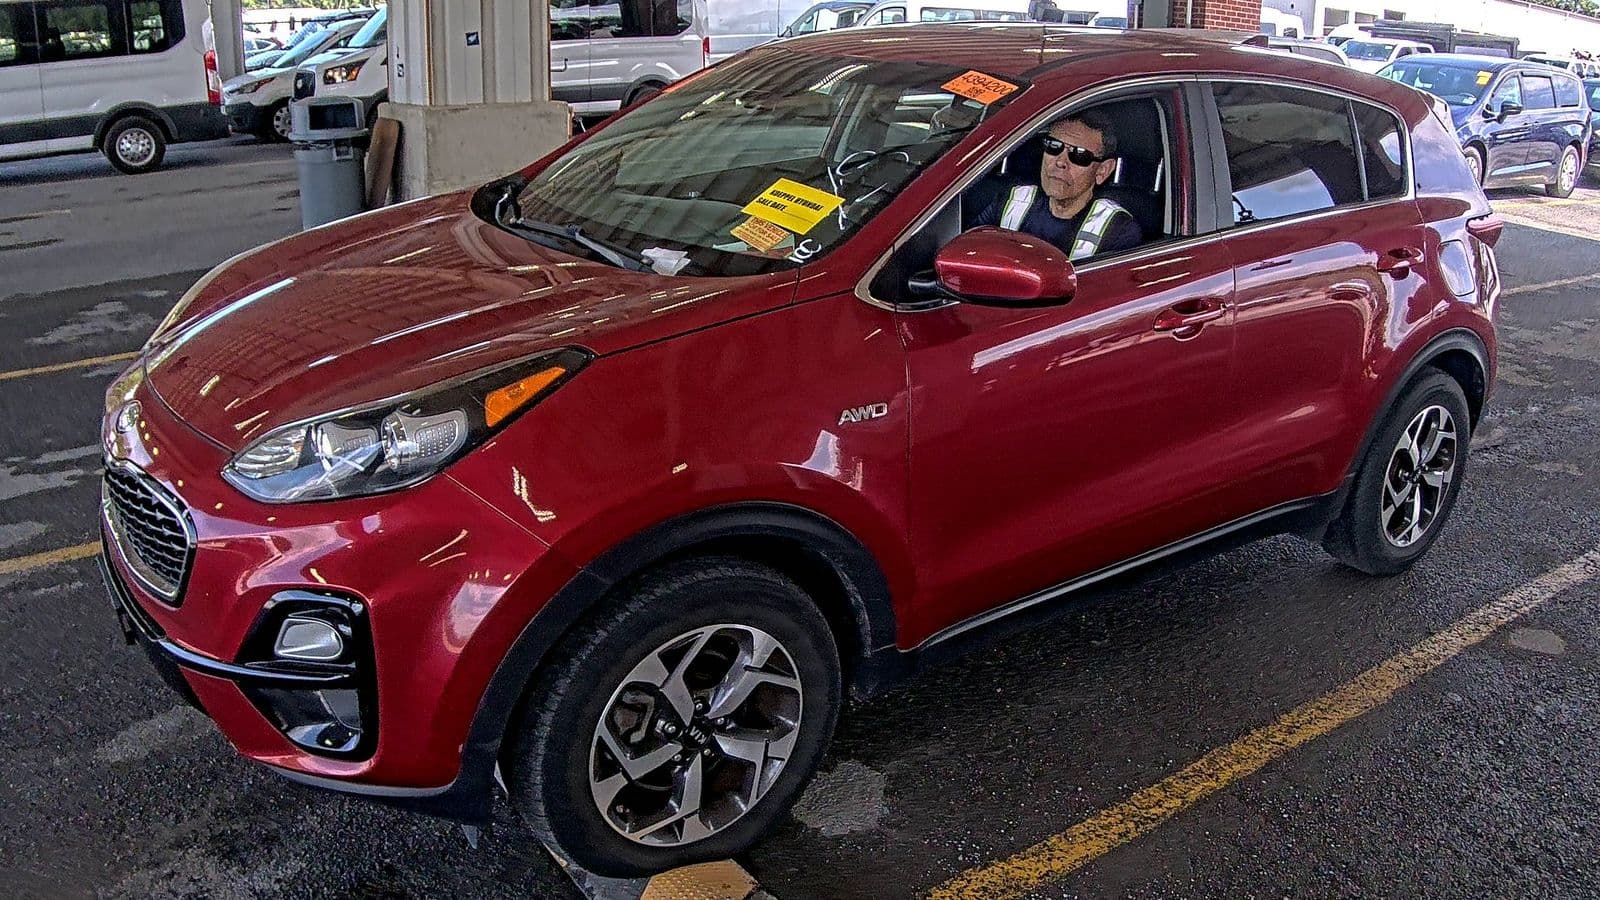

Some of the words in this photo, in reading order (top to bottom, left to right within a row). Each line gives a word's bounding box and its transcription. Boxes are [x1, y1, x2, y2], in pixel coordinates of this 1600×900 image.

[756, 197, 772, 206] SALE
[769, 201, 787, 211] DATE
[794, 197, 824, 211] HYUNDAI
[838, 403, 888, 425] AWD
